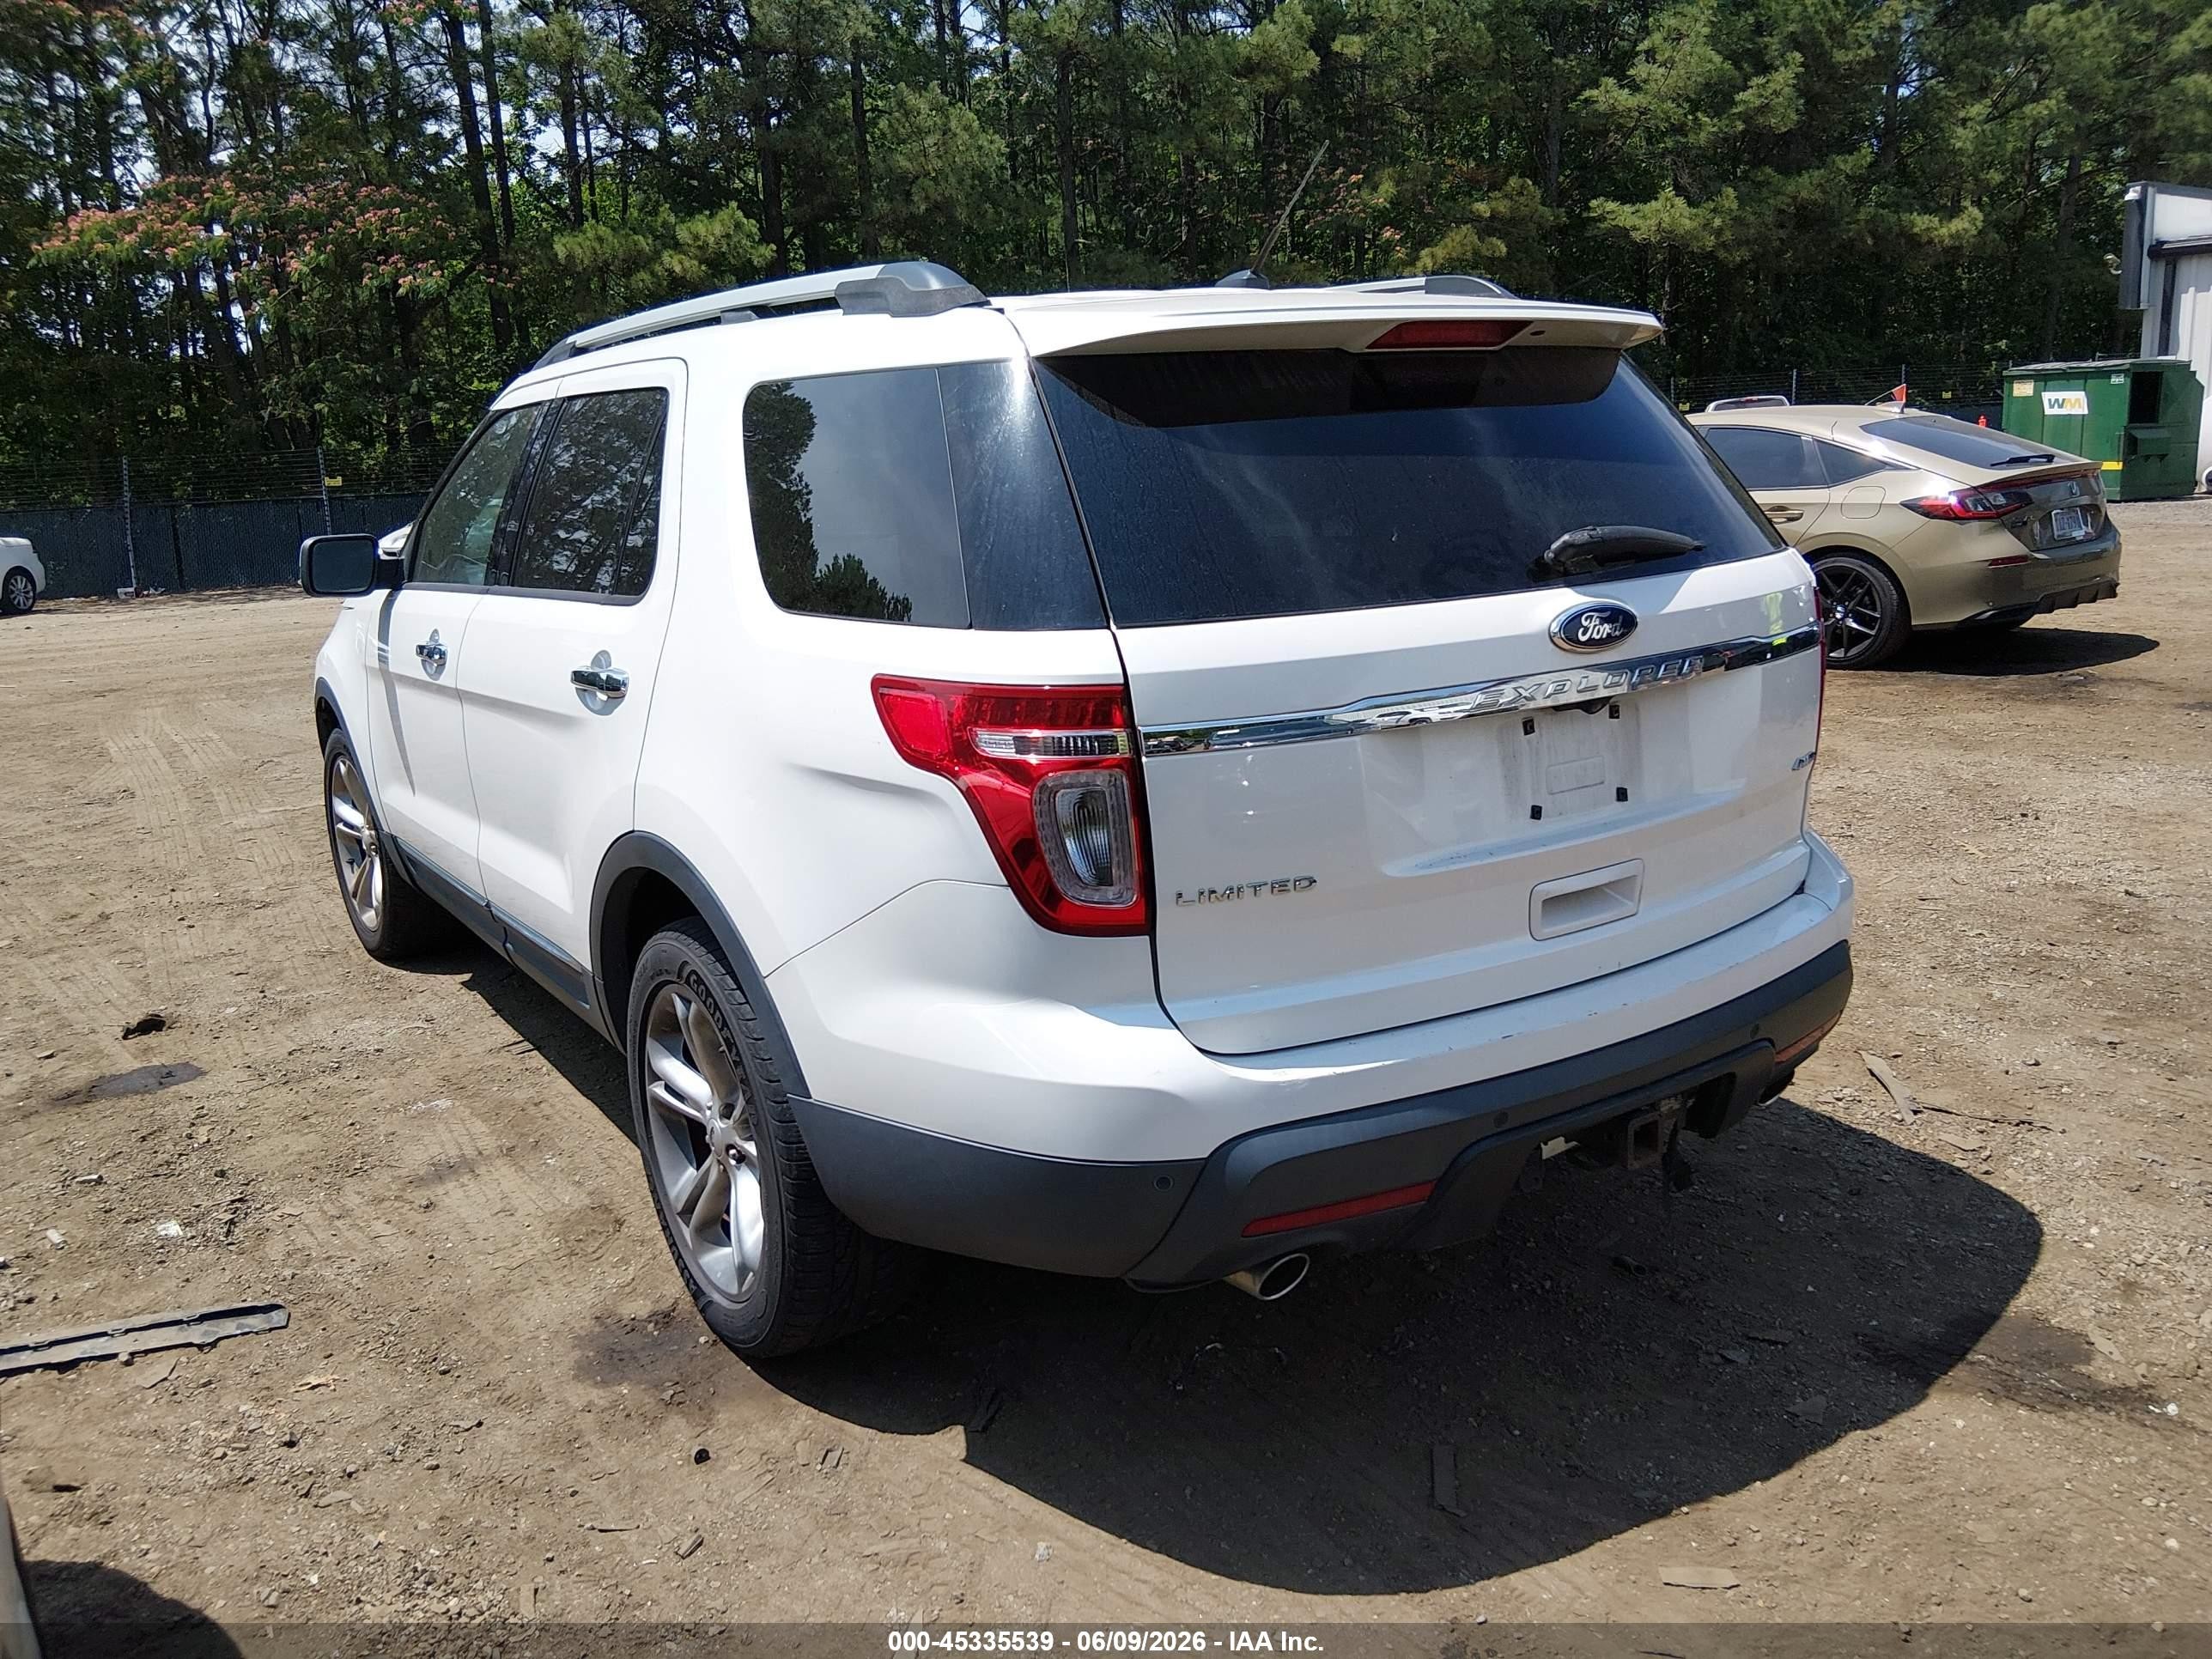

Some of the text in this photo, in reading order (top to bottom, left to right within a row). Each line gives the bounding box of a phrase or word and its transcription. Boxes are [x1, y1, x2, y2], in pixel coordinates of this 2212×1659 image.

[2047, 398, 2082, 410] WM
[1577, 611, 1628, 642] Ford
[1469, 655, 1704, 711] EXPLORER
[1175, 875, 1317, 907] LIMITED
